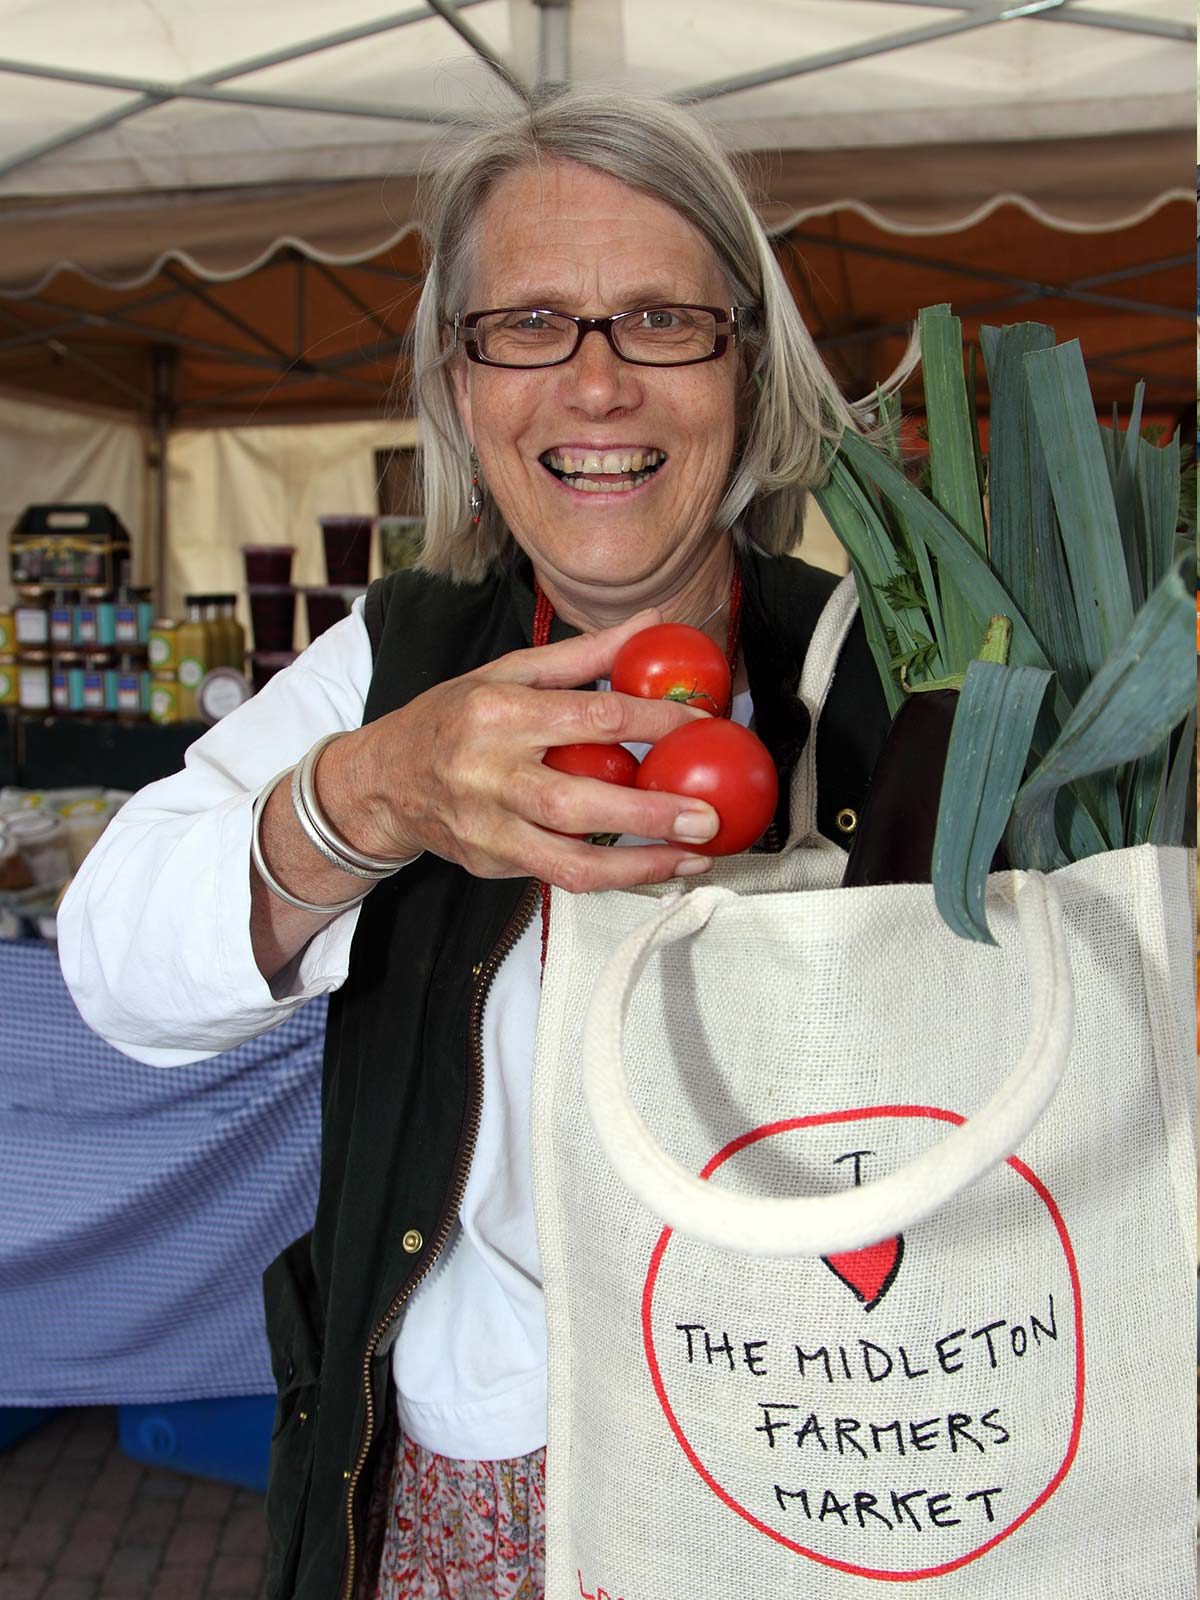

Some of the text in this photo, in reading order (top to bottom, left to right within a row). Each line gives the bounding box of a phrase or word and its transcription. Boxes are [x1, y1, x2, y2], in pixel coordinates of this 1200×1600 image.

[676, 1294, 1058, 1383] THE MIDLETON
[755, 1403, 1010, 1459] FARMERS
[774, 1485, 1002, 1532] MARKET
